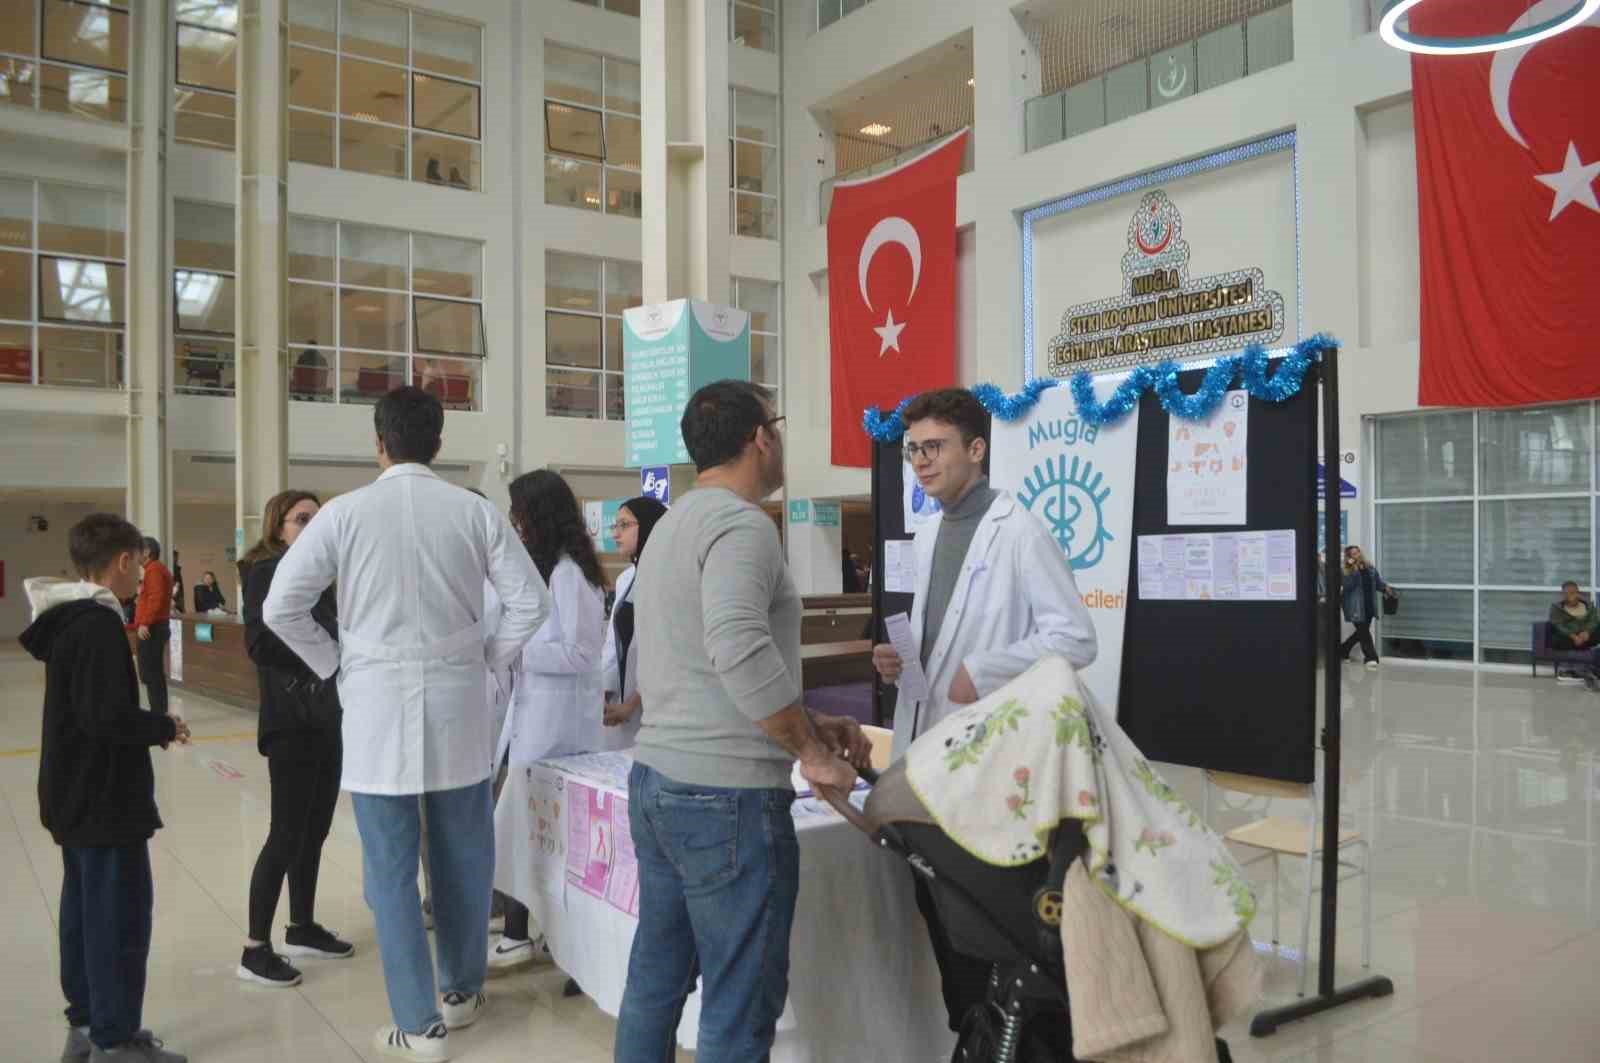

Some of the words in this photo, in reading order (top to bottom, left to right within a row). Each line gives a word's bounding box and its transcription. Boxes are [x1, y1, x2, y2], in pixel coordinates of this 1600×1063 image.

[1070, 313, 1099, 336] SITKI
[1102, 303, 1155, 331] KOÇMAN
[1157, 277, 1253, 319] ÜNİVERSİTESİ
[1132, 268, 1180, 297] MUĞLA
[1055, 339, 1097, 365] EĞİTİM
[1099, 337, 1113, 357] VE
[1113, 323, 1191, 354] ARAŞTIRMA
[1193, 303, 1273, 341] HASTANESİ
[1028, 409, 1098, 450] Muğla
